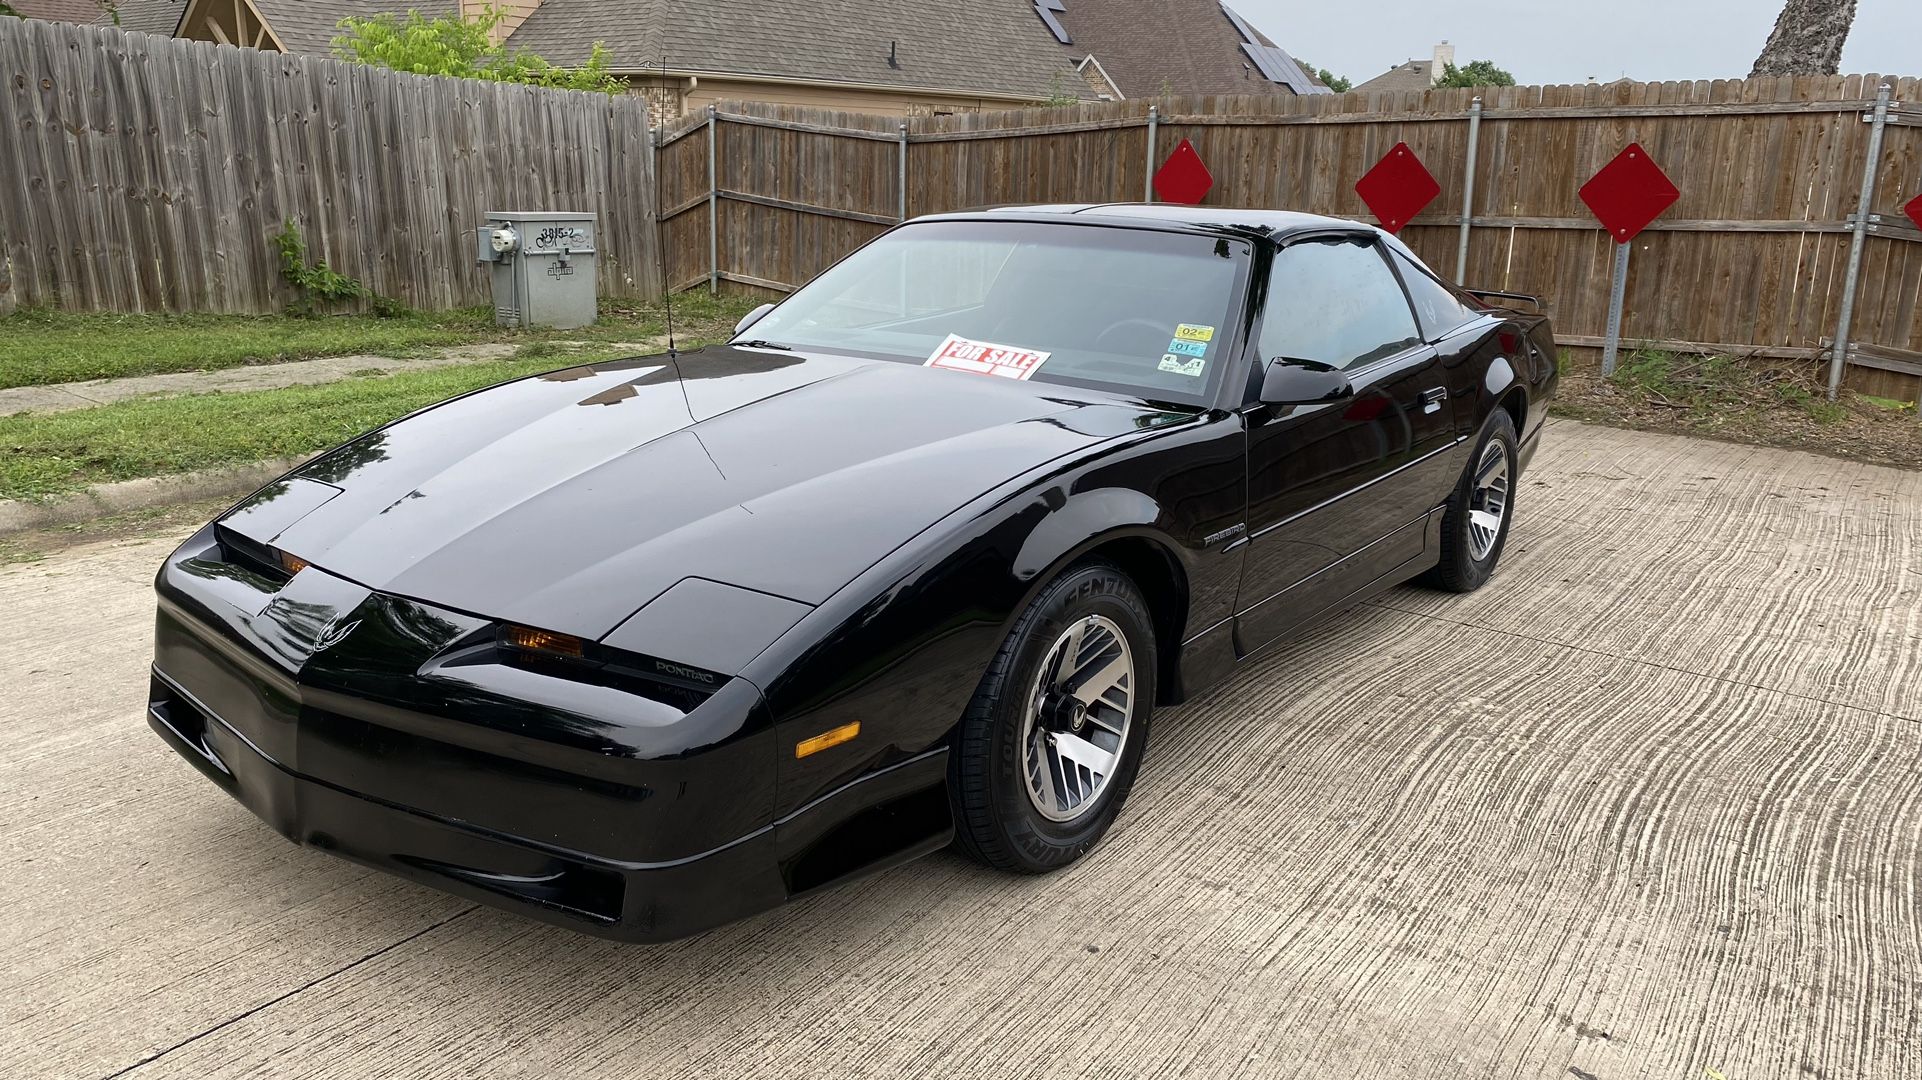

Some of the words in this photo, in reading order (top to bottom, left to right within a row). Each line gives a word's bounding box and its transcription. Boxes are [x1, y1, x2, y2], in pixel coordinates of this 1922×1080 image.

[1182, 328, 1197, 336] 02
[943, 341, 987, 362] FOR
[983, 348, 1040, 370] SALE
[1175, 343, 1190, 351] 01
[1203, 522, 1246, 547] FIREBIRD
[655, 660, 715, 684] PONTIAC
